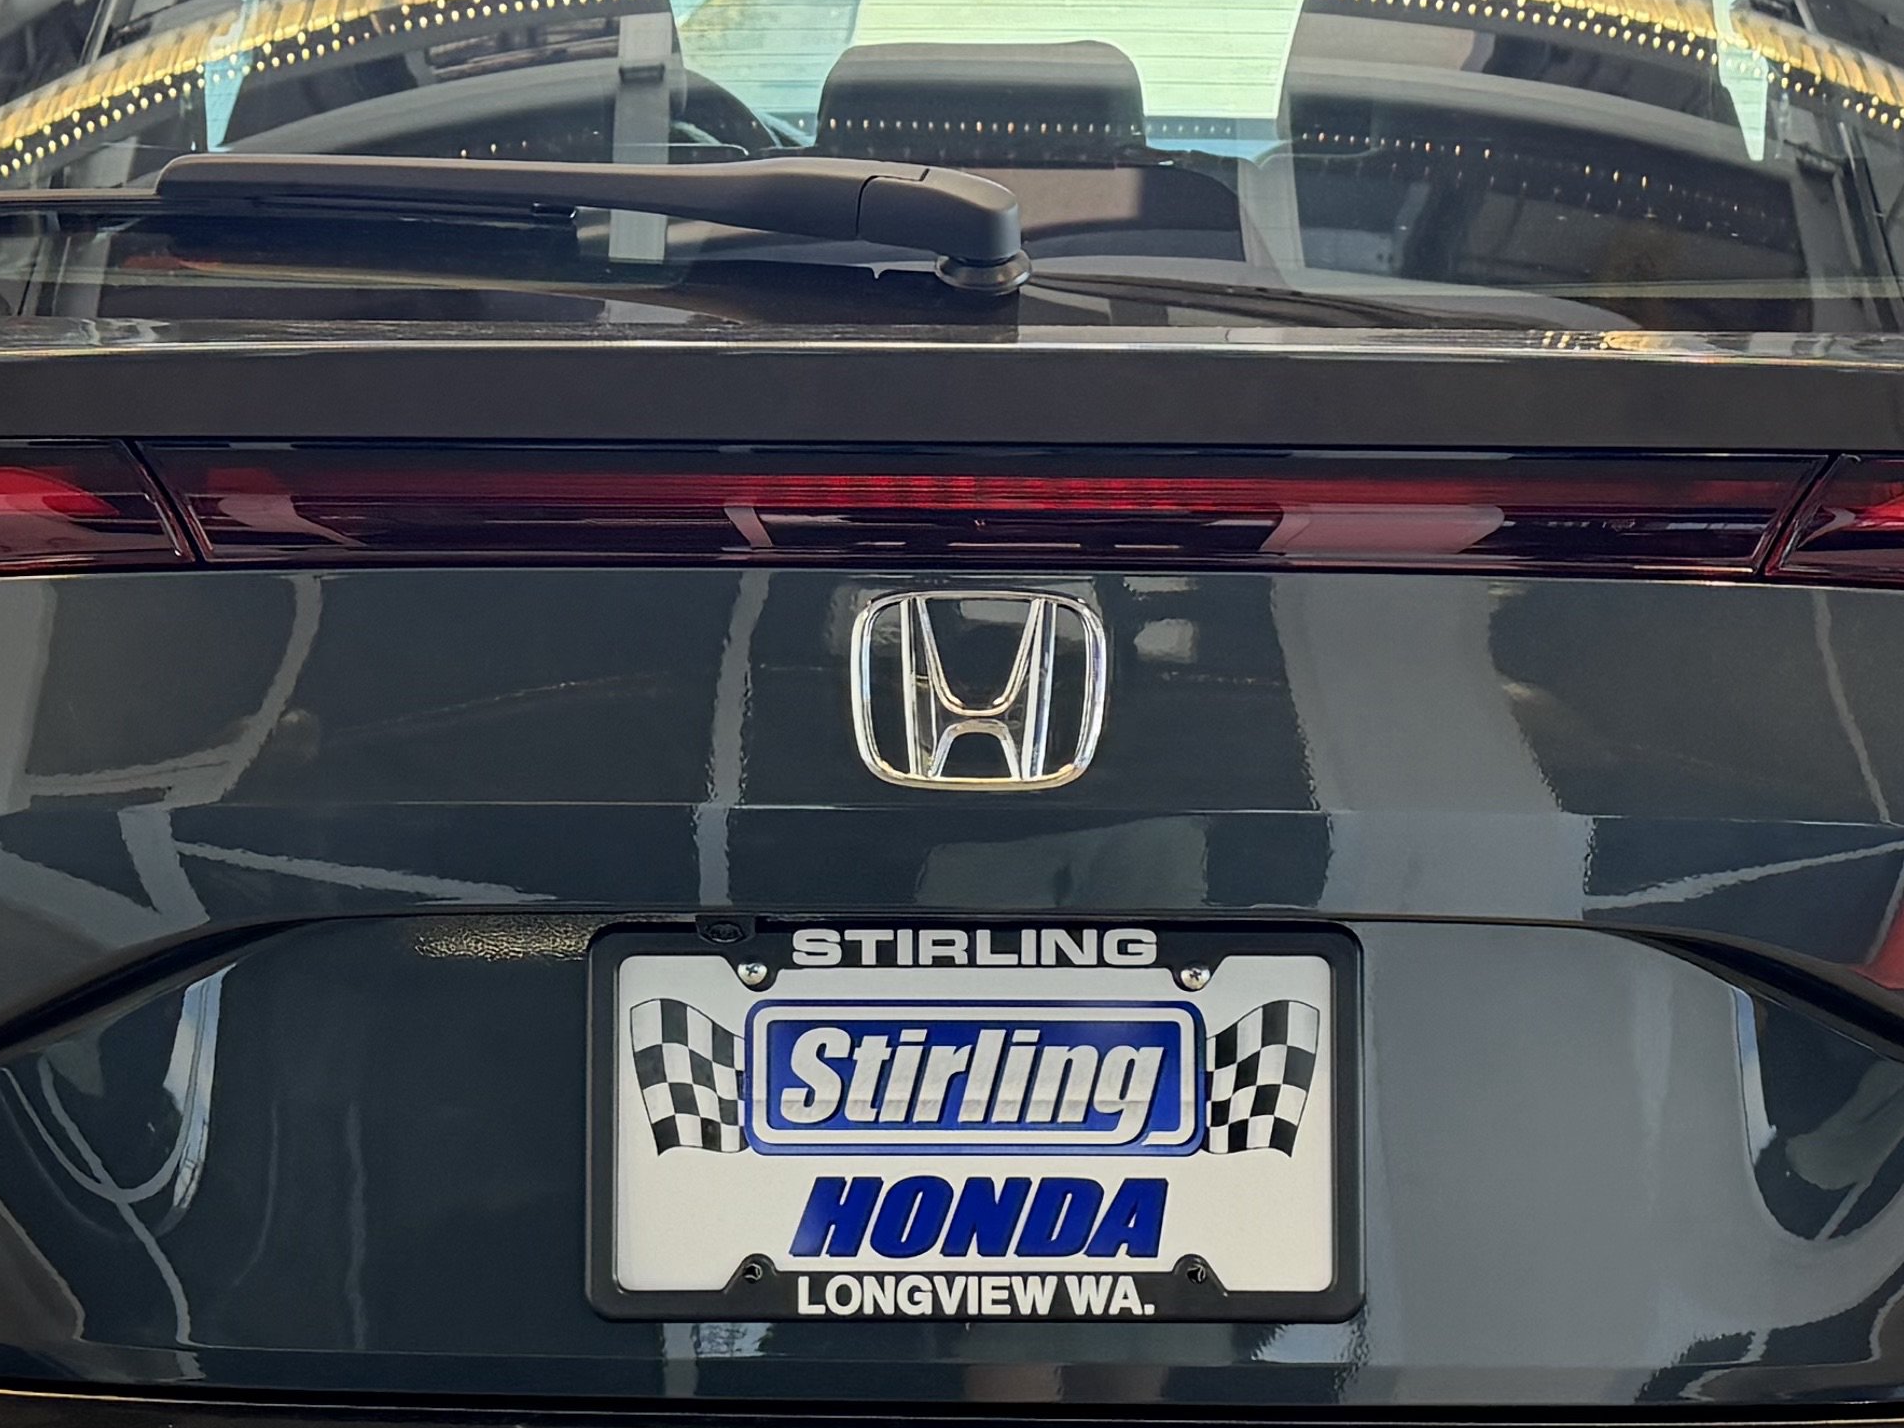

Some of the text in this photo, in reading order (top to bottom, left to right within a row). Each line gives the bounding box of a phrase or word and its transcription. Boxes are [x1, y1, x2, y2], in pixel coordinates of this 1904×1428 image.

[792, 928, 1158, 966] STIRLING
[779, 1027, 1164, 1146] Stirling
[788, 1176, 1168, 1259] HONDA
[797, 1274, 1155, 1316] LONGVIEW WA.
